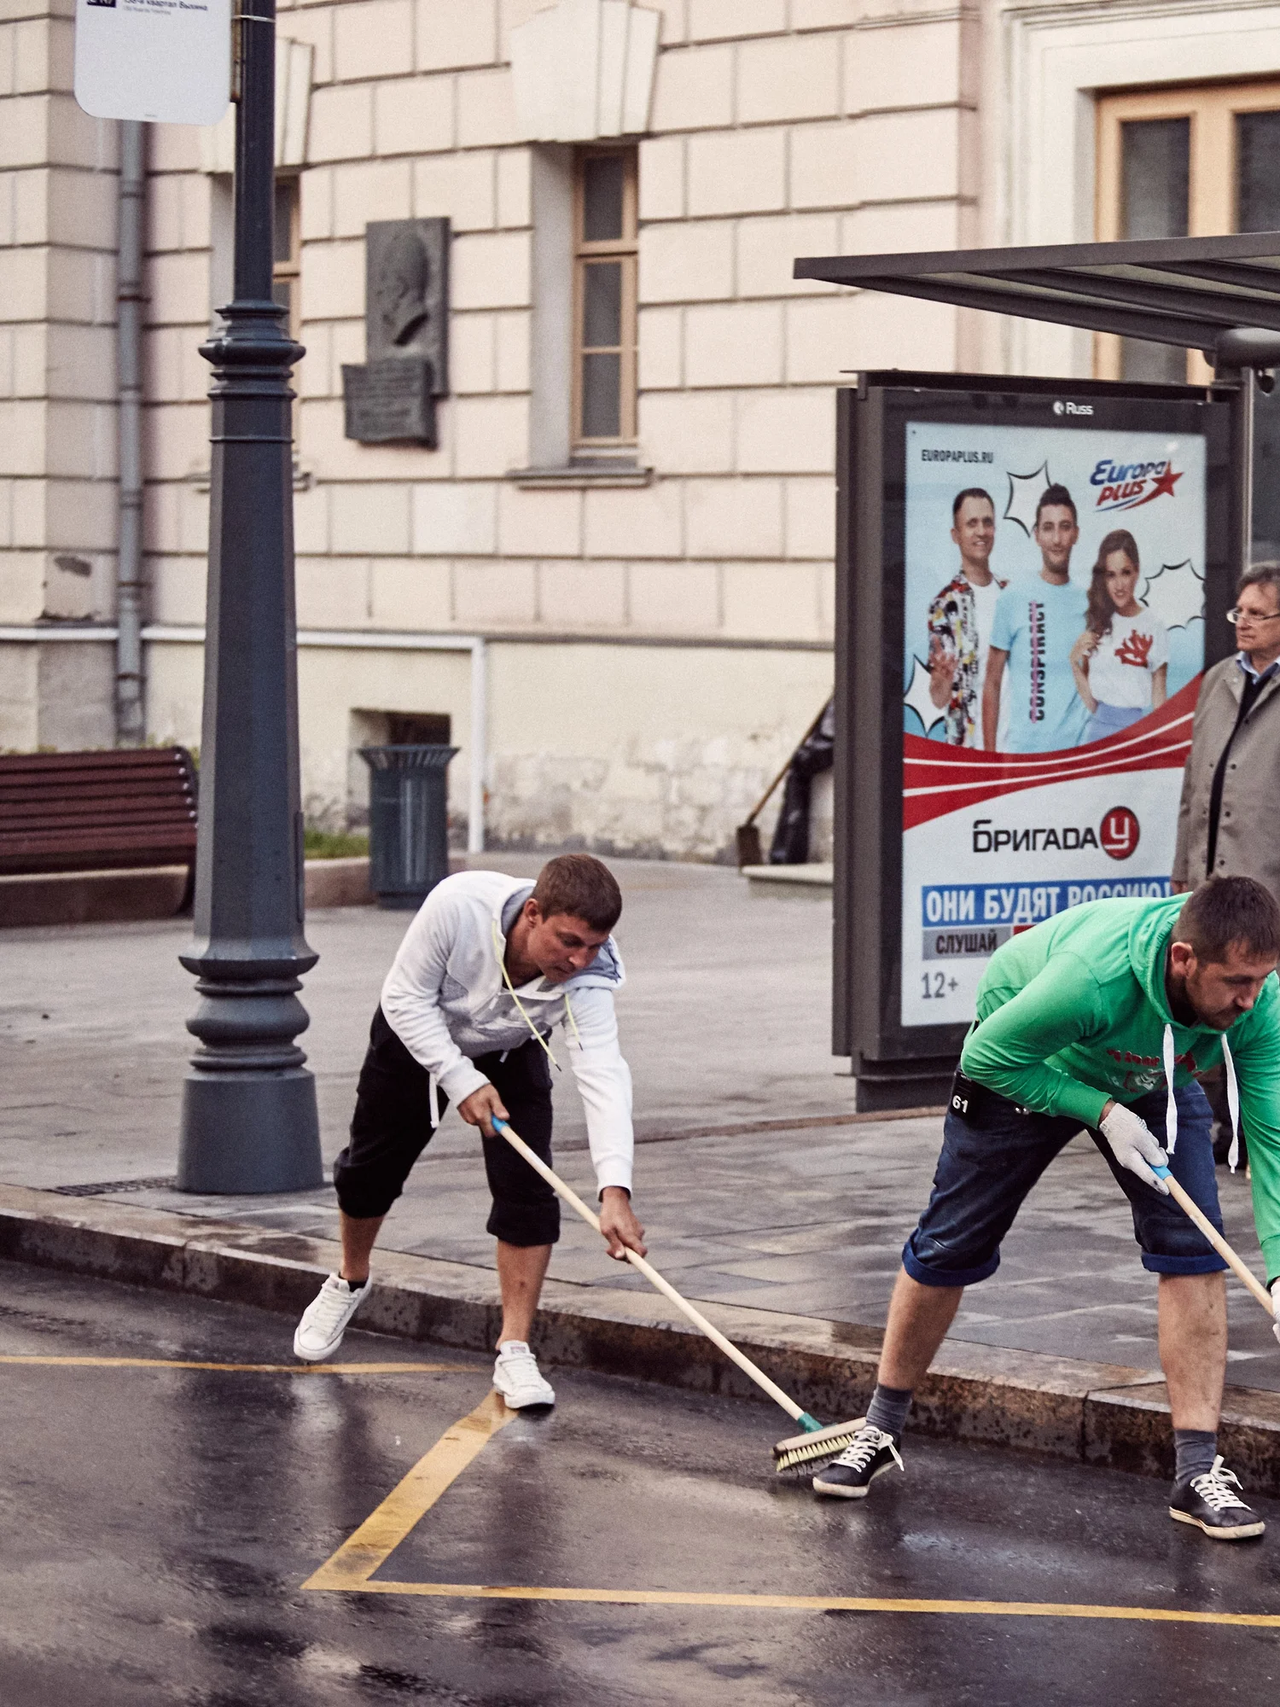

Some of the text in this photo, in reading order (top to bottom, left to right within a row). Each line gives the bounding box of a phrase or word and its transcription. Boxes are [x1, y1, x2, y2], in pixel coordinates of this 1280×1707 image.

[1065, 401, 1094, 415] Russ
[921, 449, 994, 464] EUROPAPLUS.RU
[1090, 459, 1166, 486] Europa
[972, 819, 1099, 853] БРИГАДА
[926, 890, 975, 922] ОНИ
[983, 886, 1061, 924] БУДЯТ
[935, 928, 998, 955] СЛУШАЙ
[921, 971, 959, 999] 12+
[952, 1095, 969, 1114] 61
